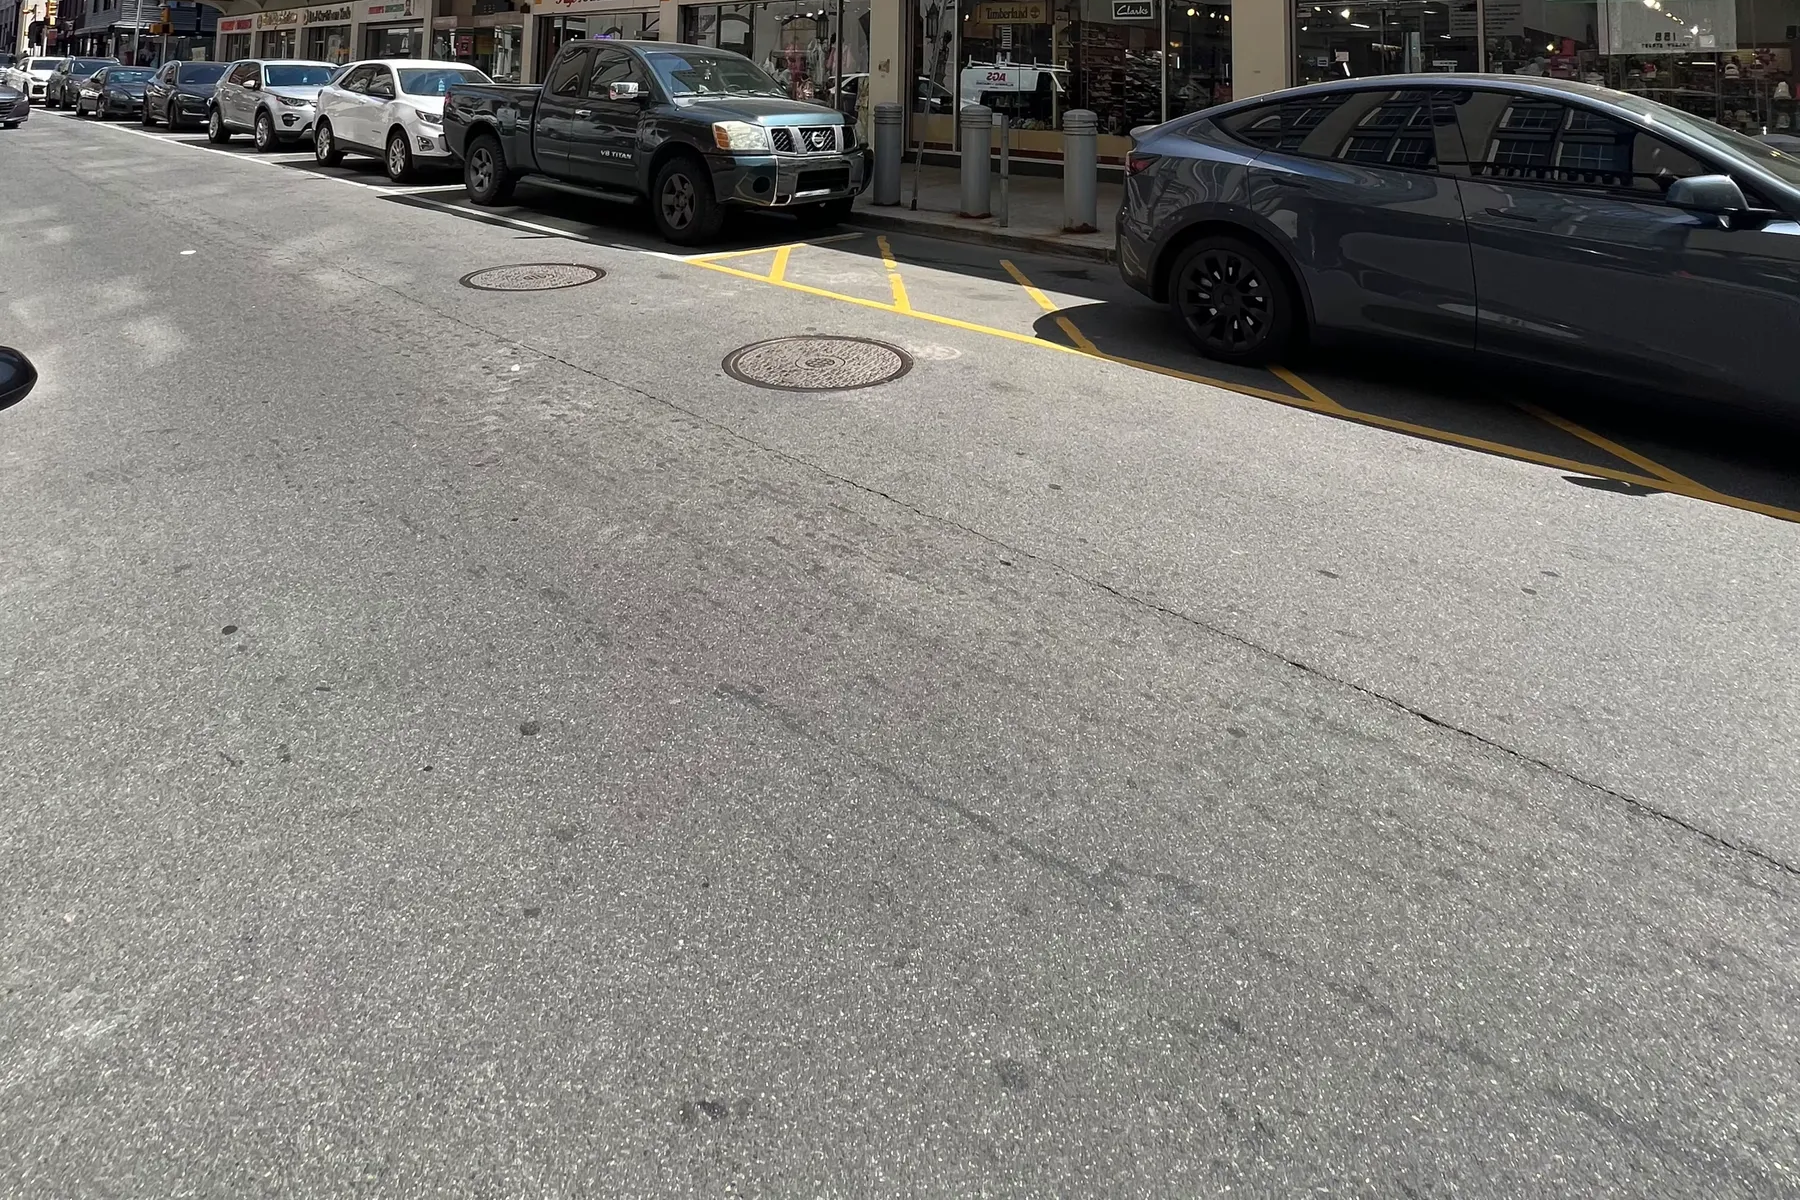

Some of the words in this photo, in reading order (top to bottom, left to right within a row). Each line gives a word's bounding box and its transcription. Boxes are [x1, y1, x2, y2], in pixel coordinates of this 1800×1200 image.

[986, 6, 1028, 20] Timberland
[1116, 4, 1150, 16] Clarks
[611, 151, 632, 159] TITAN
